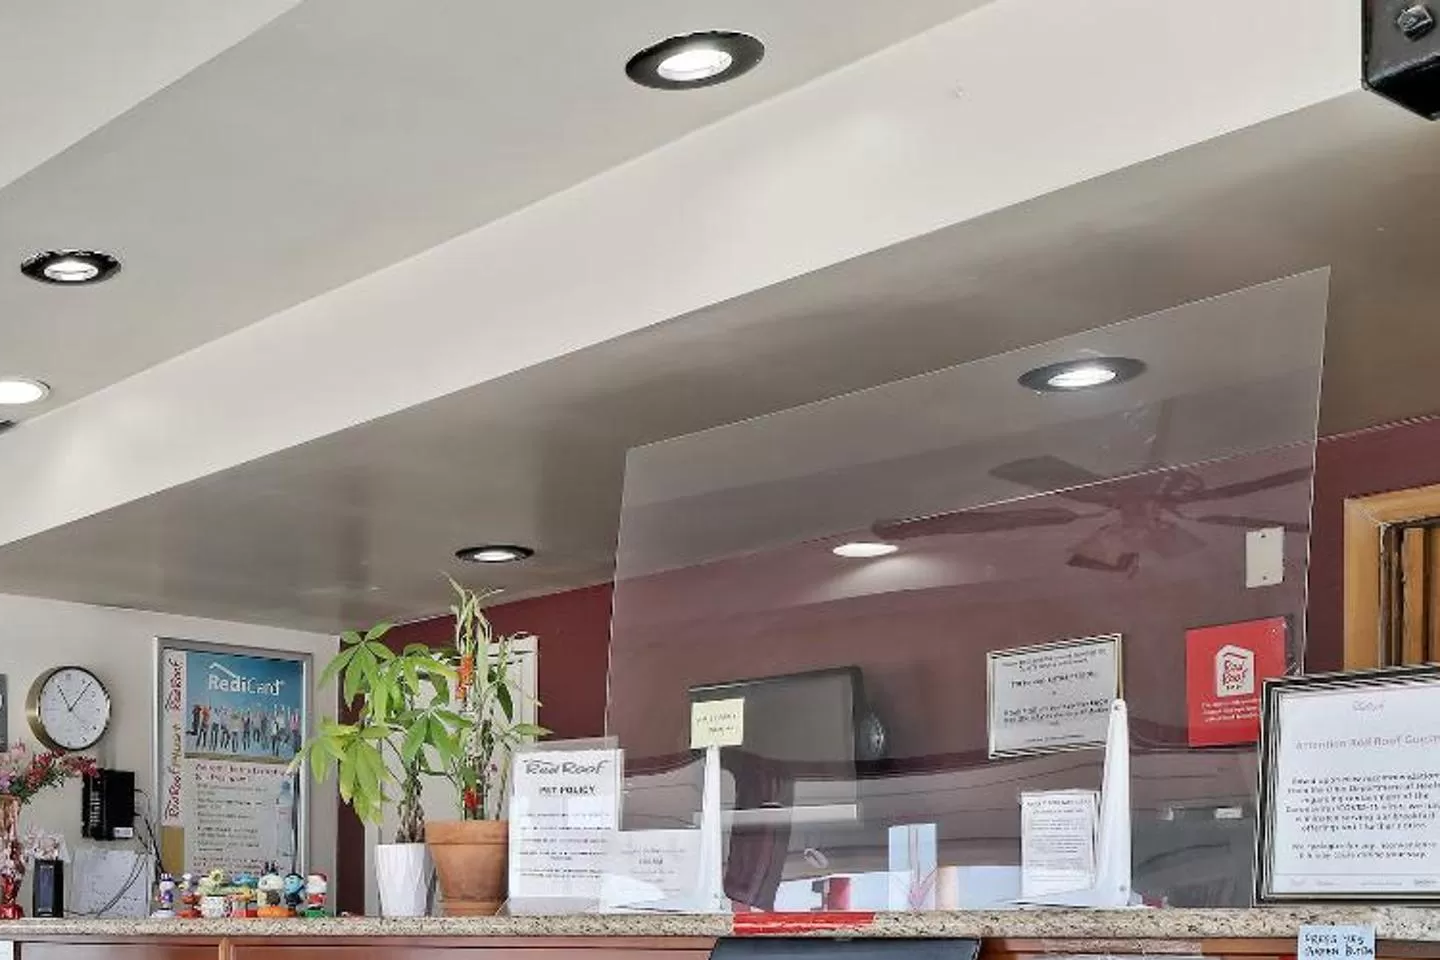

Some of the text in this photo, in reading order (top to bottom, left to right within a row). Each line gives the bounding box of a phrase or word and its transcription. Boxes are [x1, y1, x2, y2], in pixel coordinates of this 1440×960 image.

[208, 674, 280, 697] RediCard
[525, 760, 610, 775] Red Roof
[560, 785, 596, 795] POLICY
